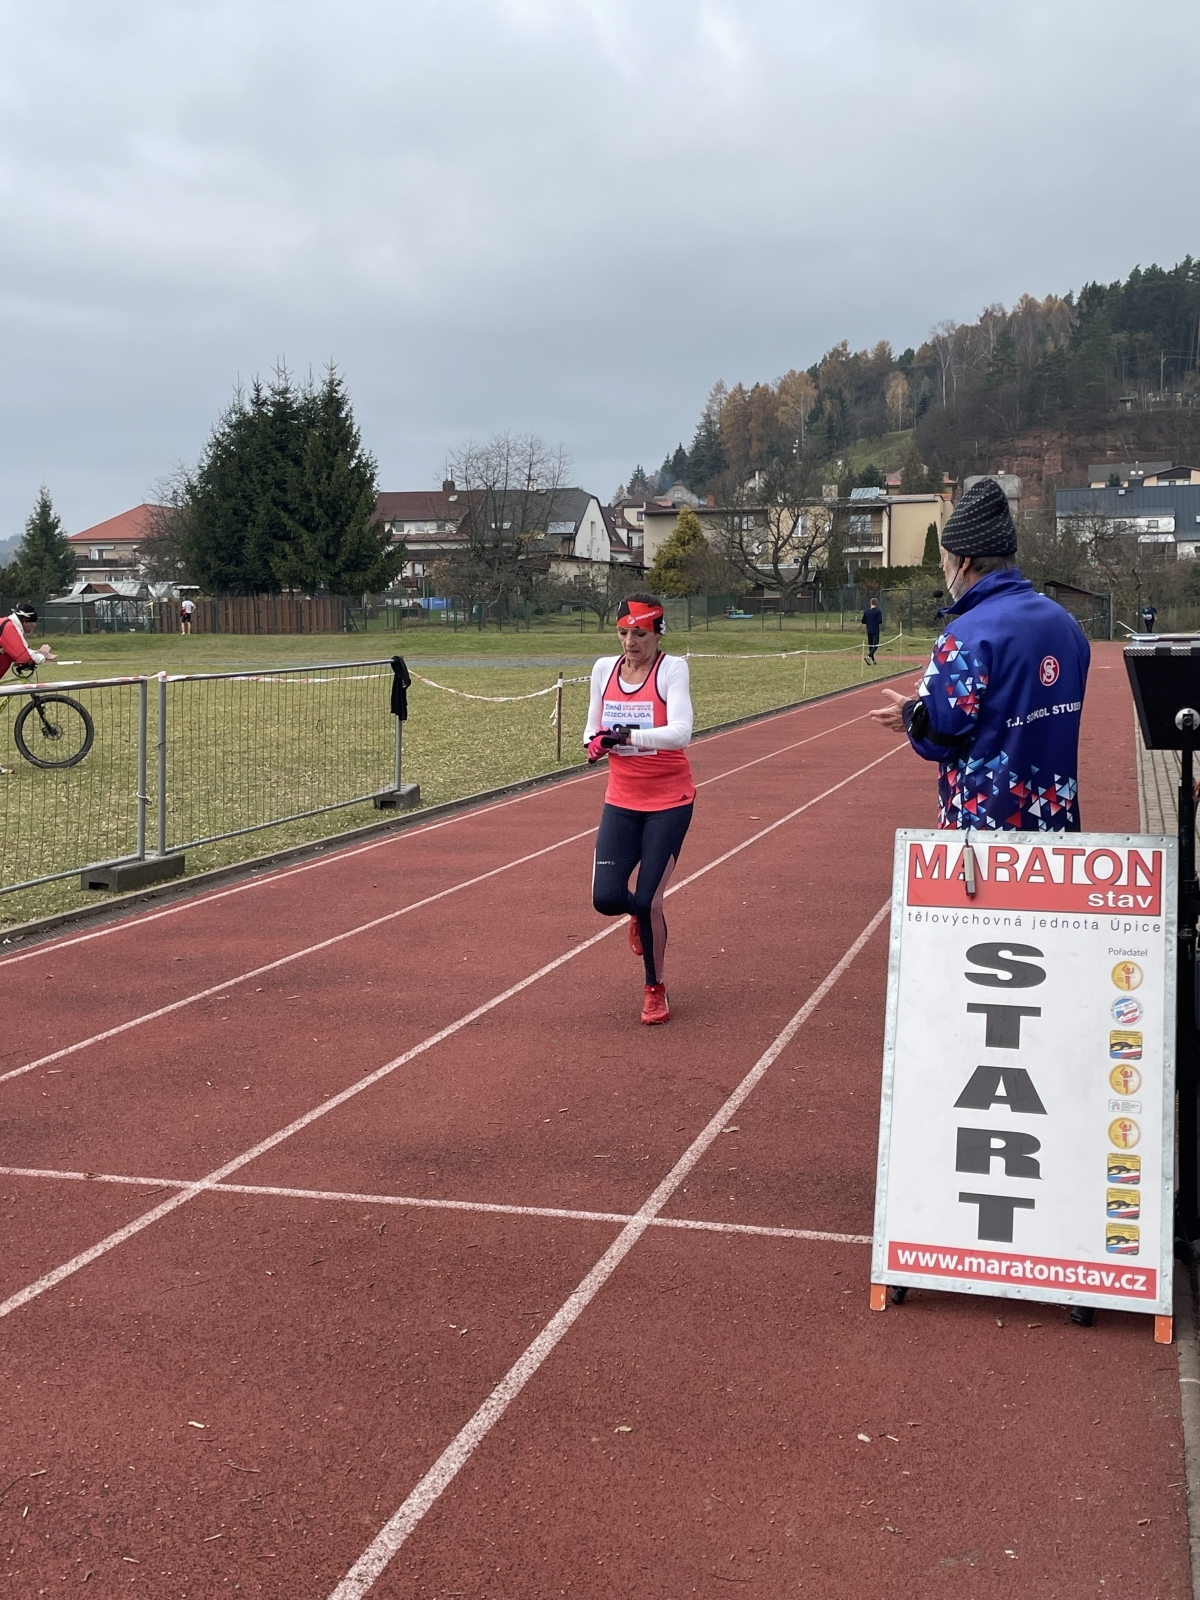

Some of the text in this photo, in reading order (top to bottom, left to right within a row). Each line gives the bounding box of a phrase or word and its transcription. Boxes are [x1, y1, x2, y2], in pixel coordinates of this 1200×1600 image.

[1005, 716, 1024, 728] T.J.
[1026, 707, 1050, 724] SOKOL
[909, 843, 1162, 887] MARATON
[1087, 891, 1154, 909] stav
[908, 912, 1161, 934] tělovýchovná jednota Úpice
[1108, 947, 1148, 957] Pořadatel
[953, 941, 1048, 1244] START
[896, 1248, 1148, 1291] www.maratonstav.cz
